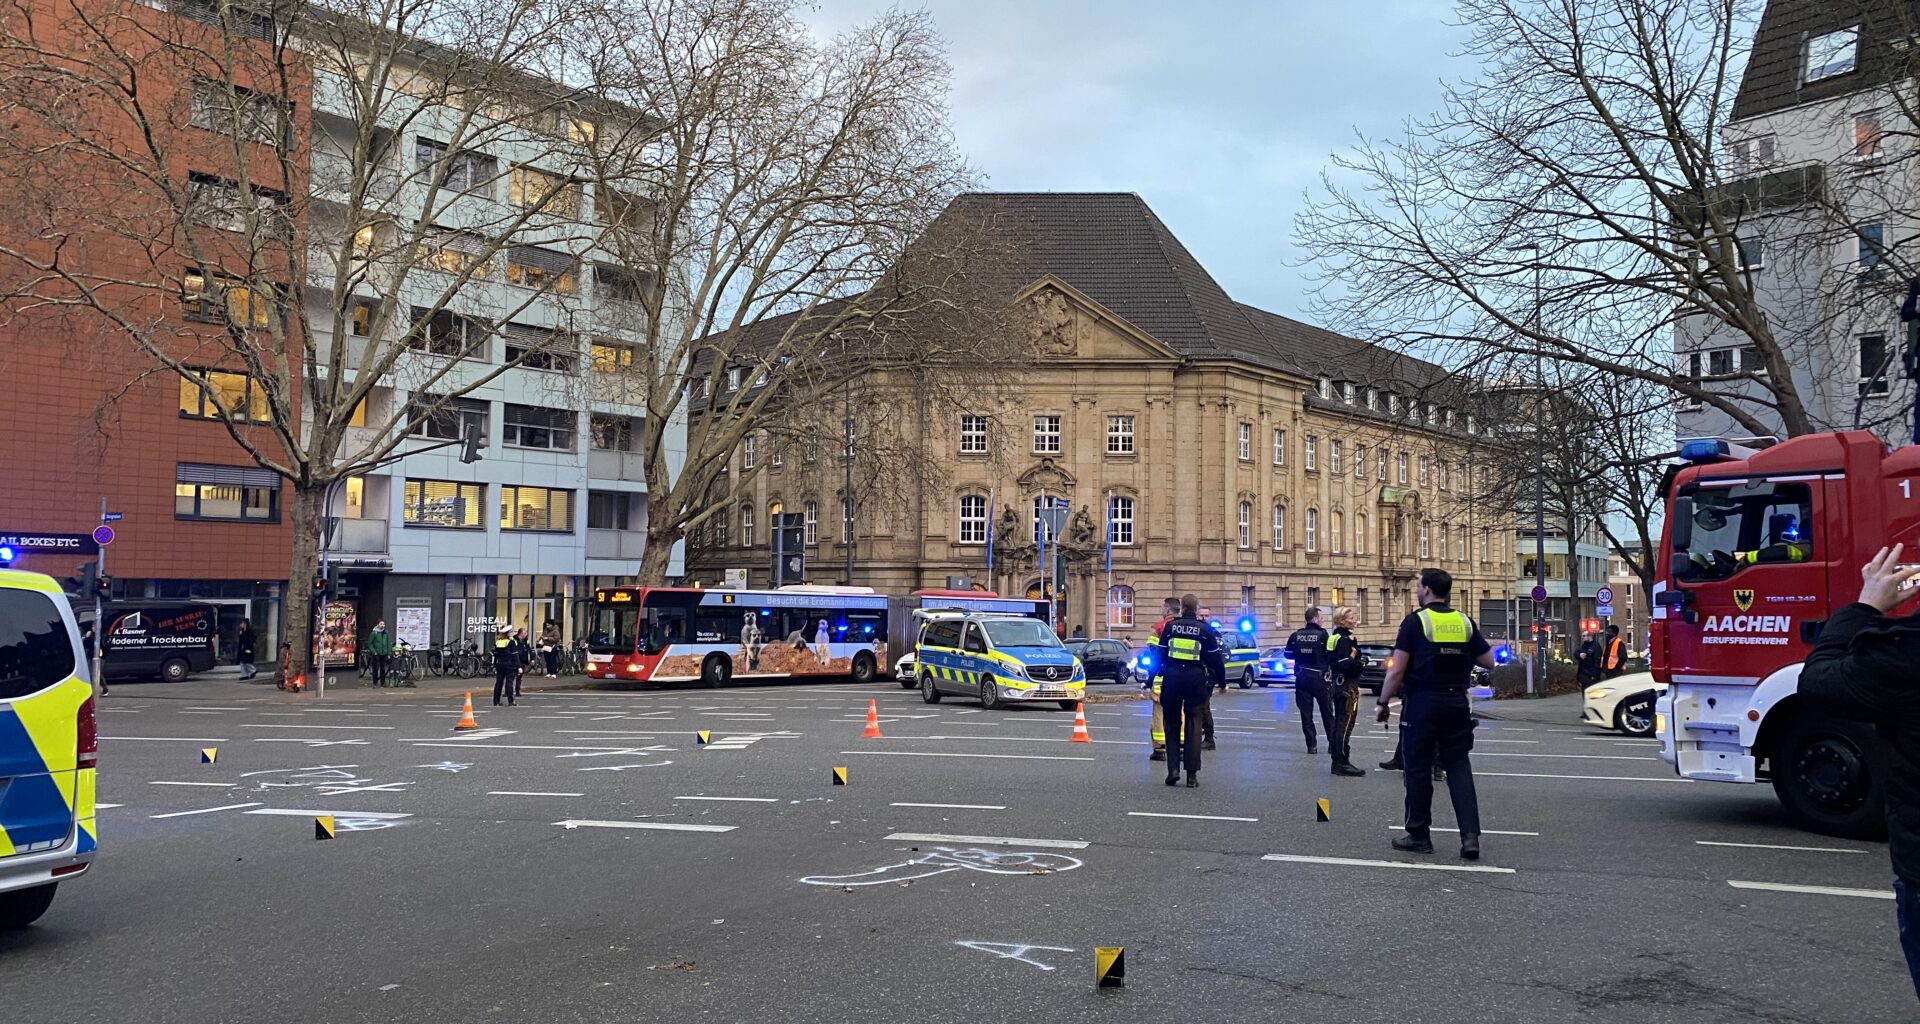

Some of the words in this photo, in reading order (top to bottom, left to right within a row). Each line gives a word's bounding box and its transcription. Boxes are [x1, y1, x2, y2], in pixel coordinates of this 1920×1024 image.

[20, 537, 56, 546] BOXES
[766, 595, 796, 605] Besucht
[799, 596, 809, 605] die
[1599, 591, 1610, 600] 30
[467, 617, 507, 625] BUREAU
[1703, 615, 1791, 633] AACHEN
[1172, 624, 1200, 636] POLIZEI
[1435, 624, 1463, 634] POLIZEI
[152, 636, 207, 644] Trockenbau
[1297, 634, 1318, 642] POLIZEI
[1702, 636, 1789, 645] BERUFSFEUERWEHR
